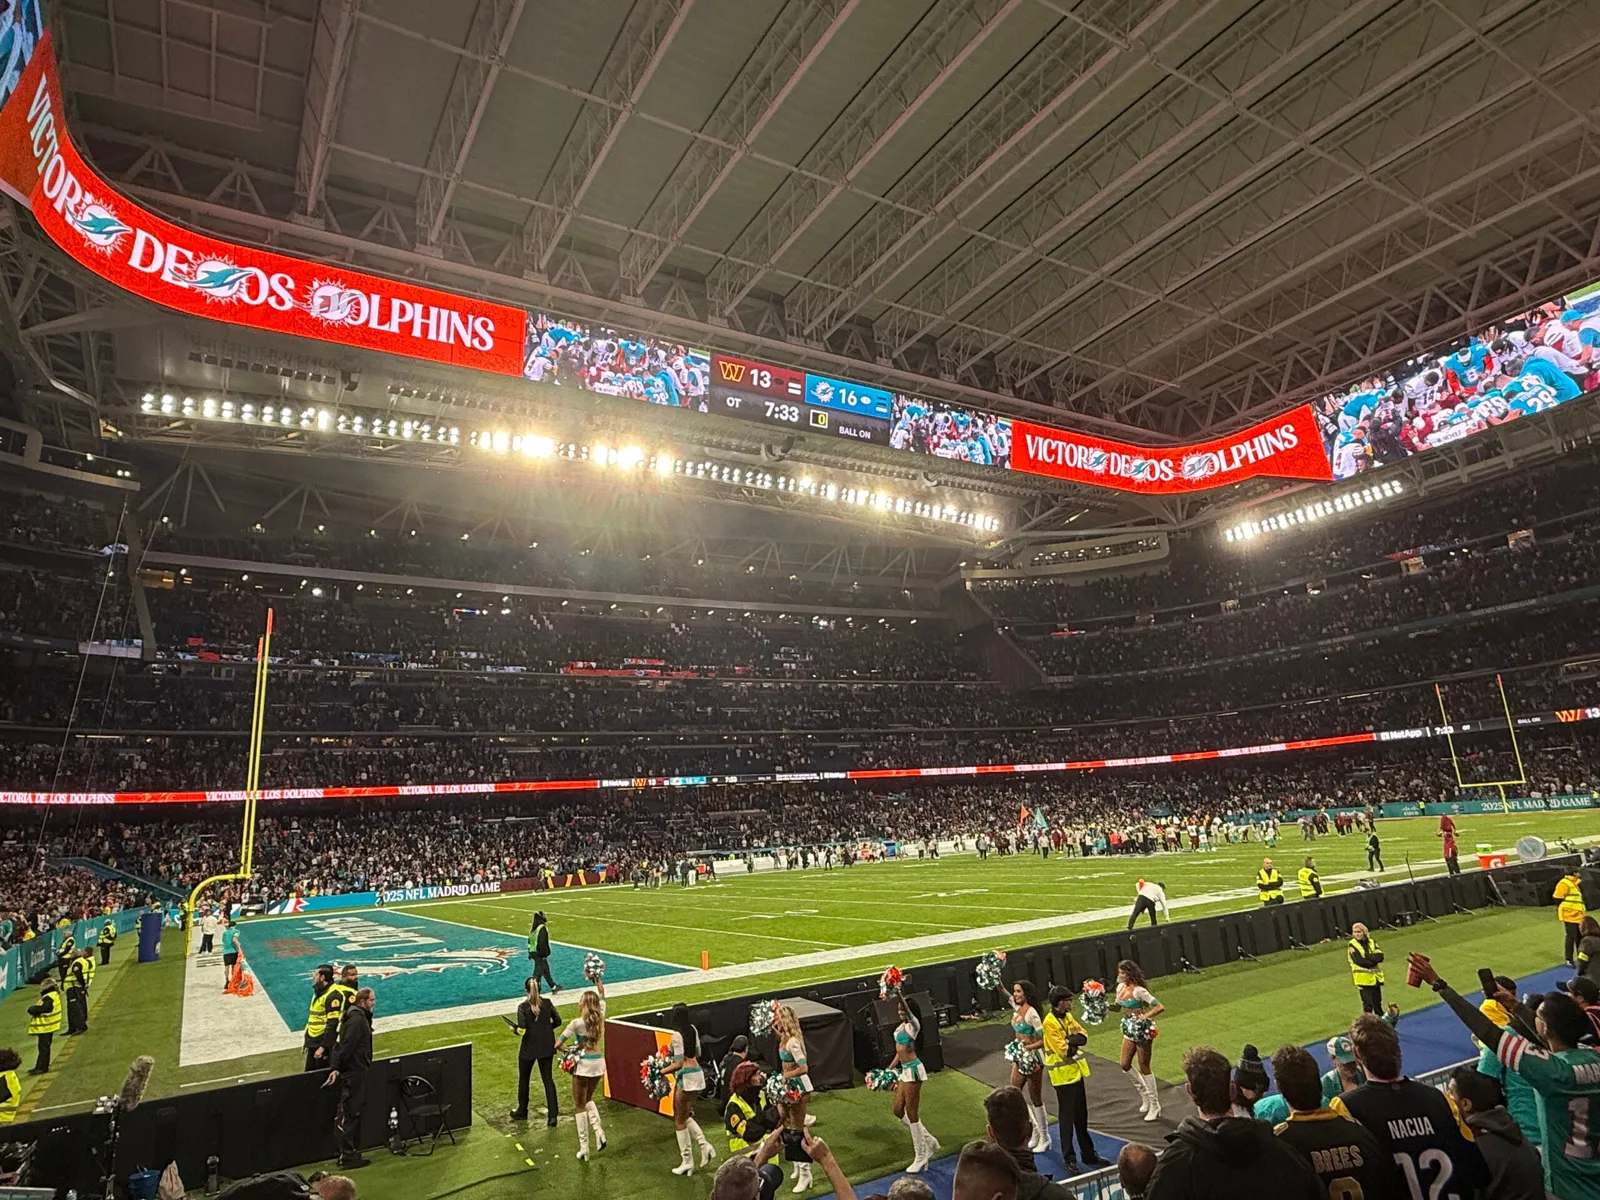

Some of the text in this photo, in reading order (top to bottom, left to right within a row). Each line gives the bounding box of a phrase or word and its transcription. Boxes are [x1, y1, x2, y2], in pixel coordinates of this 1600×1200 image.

[346, 289, 495, 351] OLPHINS
[750, 368, 771, 388] 13
[839, 388, 857, 406] 16
[726, 397, 799, 422] OT 7:33
[817, 413, 827, 426] 0
[839, 426, 871, 439] BALL ON
[1025, 434, 1088, 468] VICTOR
[1205, 424, 1298, 475] OLPHINS
[1390, 729, 1422, 740] NetApp
[36, 793, 47, 804] DE
[49, 793, 68, 804] LOS
[1481, 802, 1503, 811] 2025
[1561, 796, 1591, 807] GAME
[405, 888, 426, 900] NFL
[428, 884, 469, 898] MADRID
[470, 881, 501, 894] GAME
[1387, 1116, 1435, 1140] NACUA
[1310, 1145, 1364, 1173] BREES
[1393, 1148, 1461, 1200] 12
